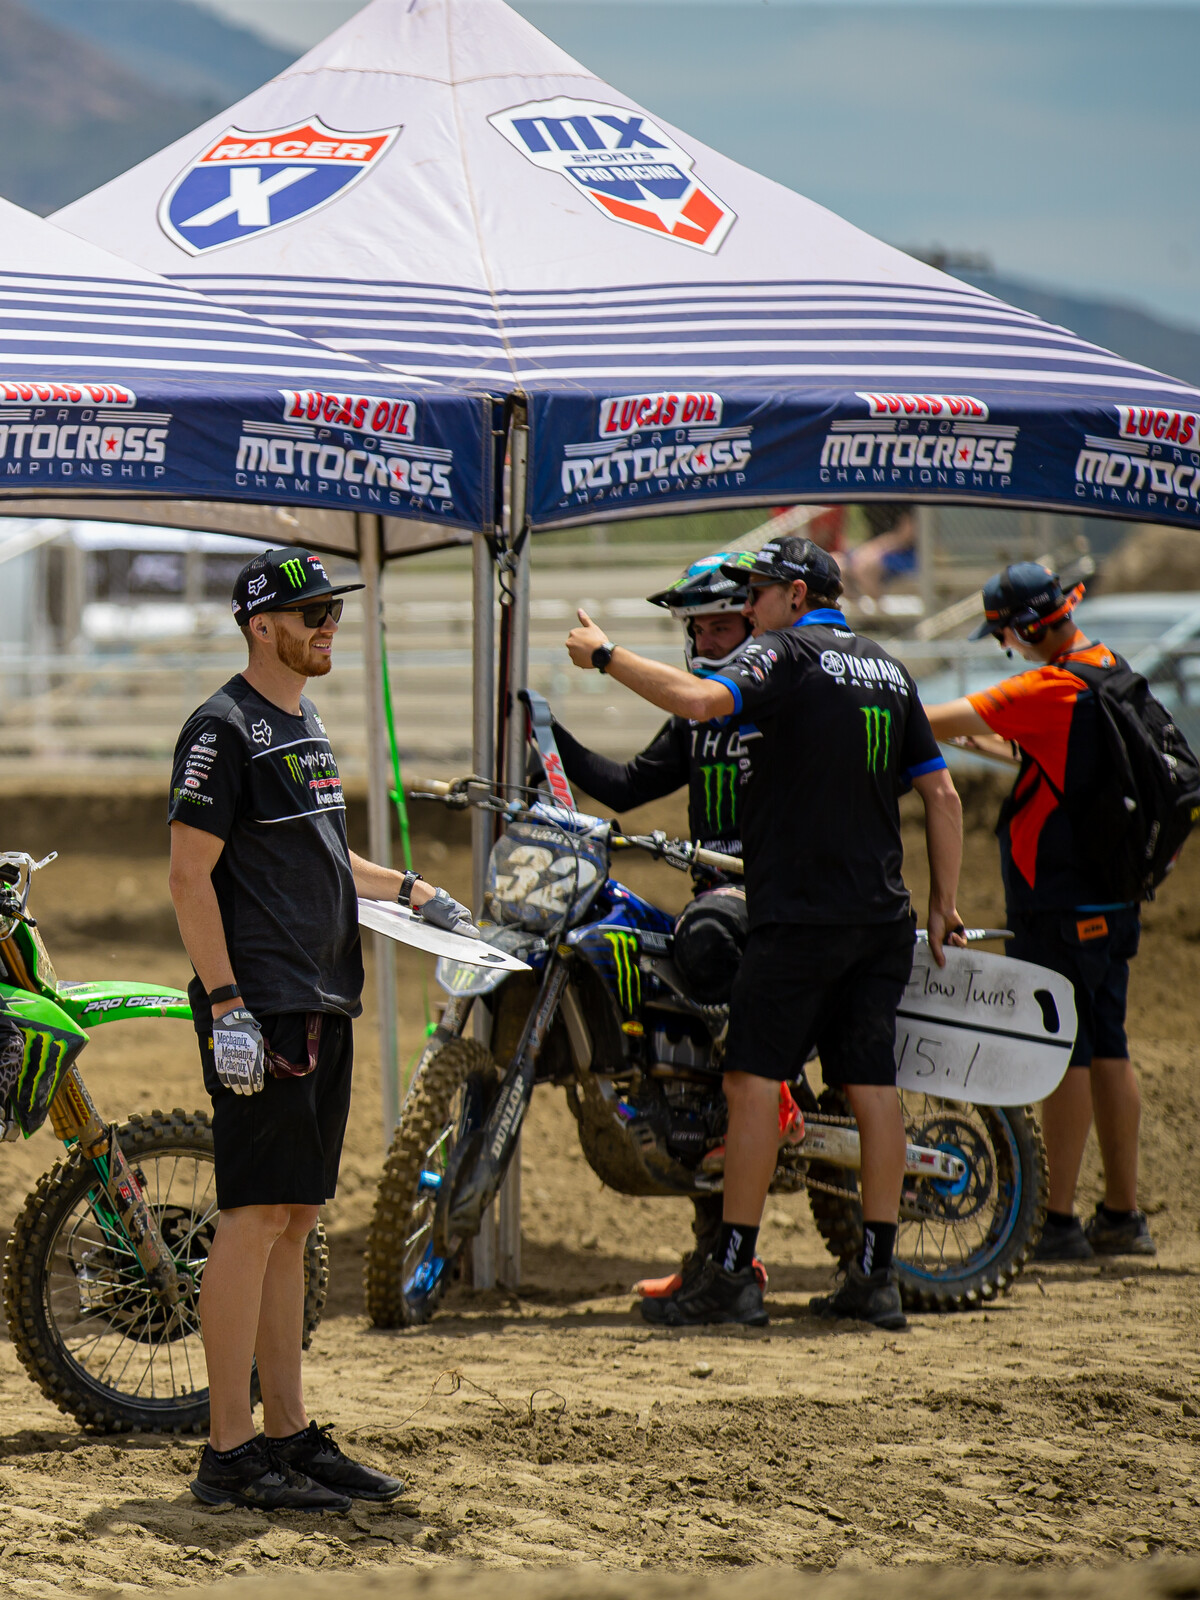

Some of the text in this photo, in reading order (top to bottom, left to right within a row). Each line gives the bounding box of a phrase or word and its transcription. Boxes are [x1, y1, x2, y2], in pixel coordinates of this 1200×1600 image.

[210, 140, 373, 160] RACER
[511, 115, 671, 152] MX
[570, 151, 656, 163] SPORTS
[571, 164, 684, 182] PRO RACING
[178, 167, 318, 227] X
[83, 384, 129, 404] OIL
[604, 392, 716, 433] LUCAS OIL
[867, 394, 983, 416] LUCAS OIL
[33, 409, 94, 422] PRO
[290, 391, 410, 435] LUCAS OIL
[898, 420, 951, 434] PRO
[1125, 406, 1196, 444] LUCAS
[318, 428, 378, 450] PRO
[631, 429, 686, 446] PRO
[820, 434, 1016, 473] MOTOCROSS
[236, 436, 453, 498] MOTOCROSS
[561, 440, 752, 494] MOTOCROSS
[819, 468, 1012, 489] CHAMPIONSHIP
[1075, 449, 1200, 499] MOTOC
[235, 472, 455, 513] CHAMPIONSHIP
[834, 676, 909, 697] RACING
[842, 652, 909, 689] YAMAHA
[189, 754, 214, 763] DUNLOP
[495, 845, 597, 914] 32
[83, 997, 124, 1013] PRO
[963, 969, 1017, 1007] Turns
[898, 1033, 981, 1088] 15.1
[491, 1074, 525, 1161] DUNLOP
